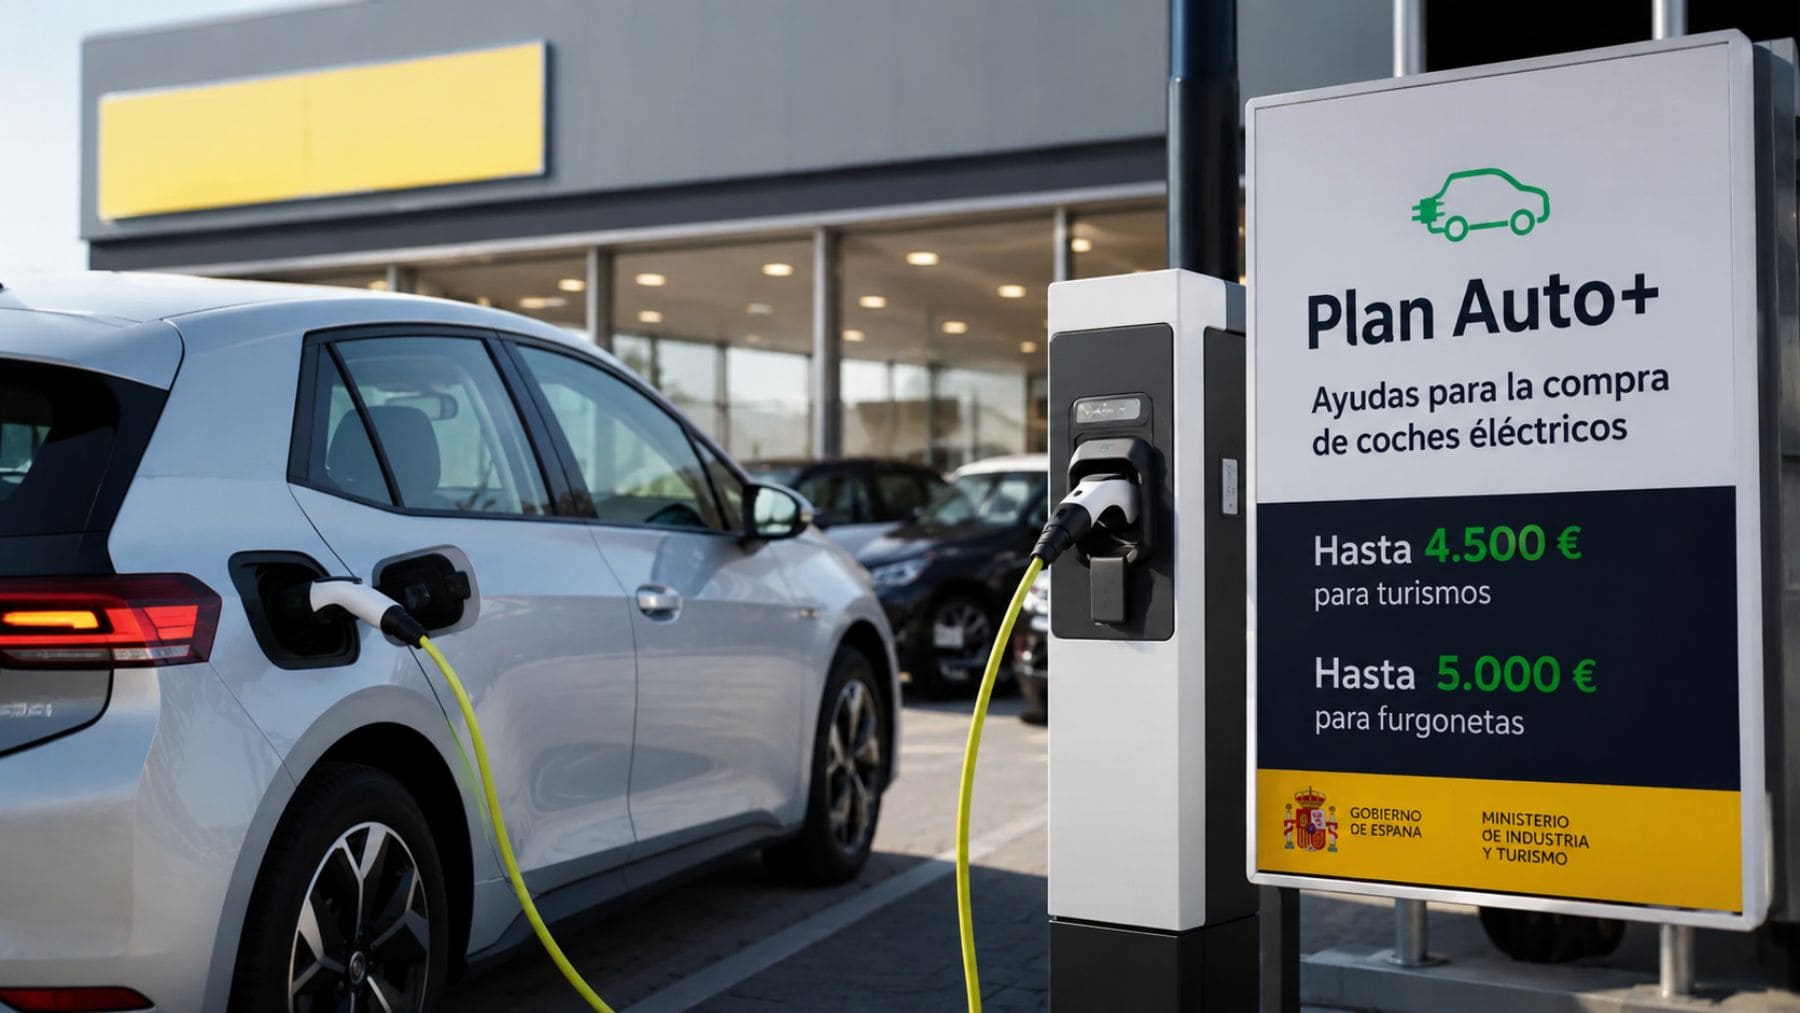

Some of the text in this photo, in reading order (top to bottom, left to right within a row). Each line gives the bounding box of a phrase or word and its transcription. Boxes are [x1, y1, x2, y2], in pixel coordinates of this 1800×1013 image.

[1308, 273, 1659, 350] Plan Auto+
[1311, 368, 1670, 420] Ayudas para la compra
[1312, 413, 1628, 457] de coches éléctricos
[1315, 524, 1582, 566] Hasta 4.500 €
[1315, 579, 1491, 612] para turismos
[1315, 655, 1597, 693] Hasta 5.000 €
[1315, 704, 1525, 739] para furgonetas
[1350, 806, 1422, 822] GOBIERNO
[1482, 811, 1569, 829] MINISTERIO
[1482, 846, 1568, 866] Y TURISMO
[1506, 830, 1590, 849] INDUSTRIA
